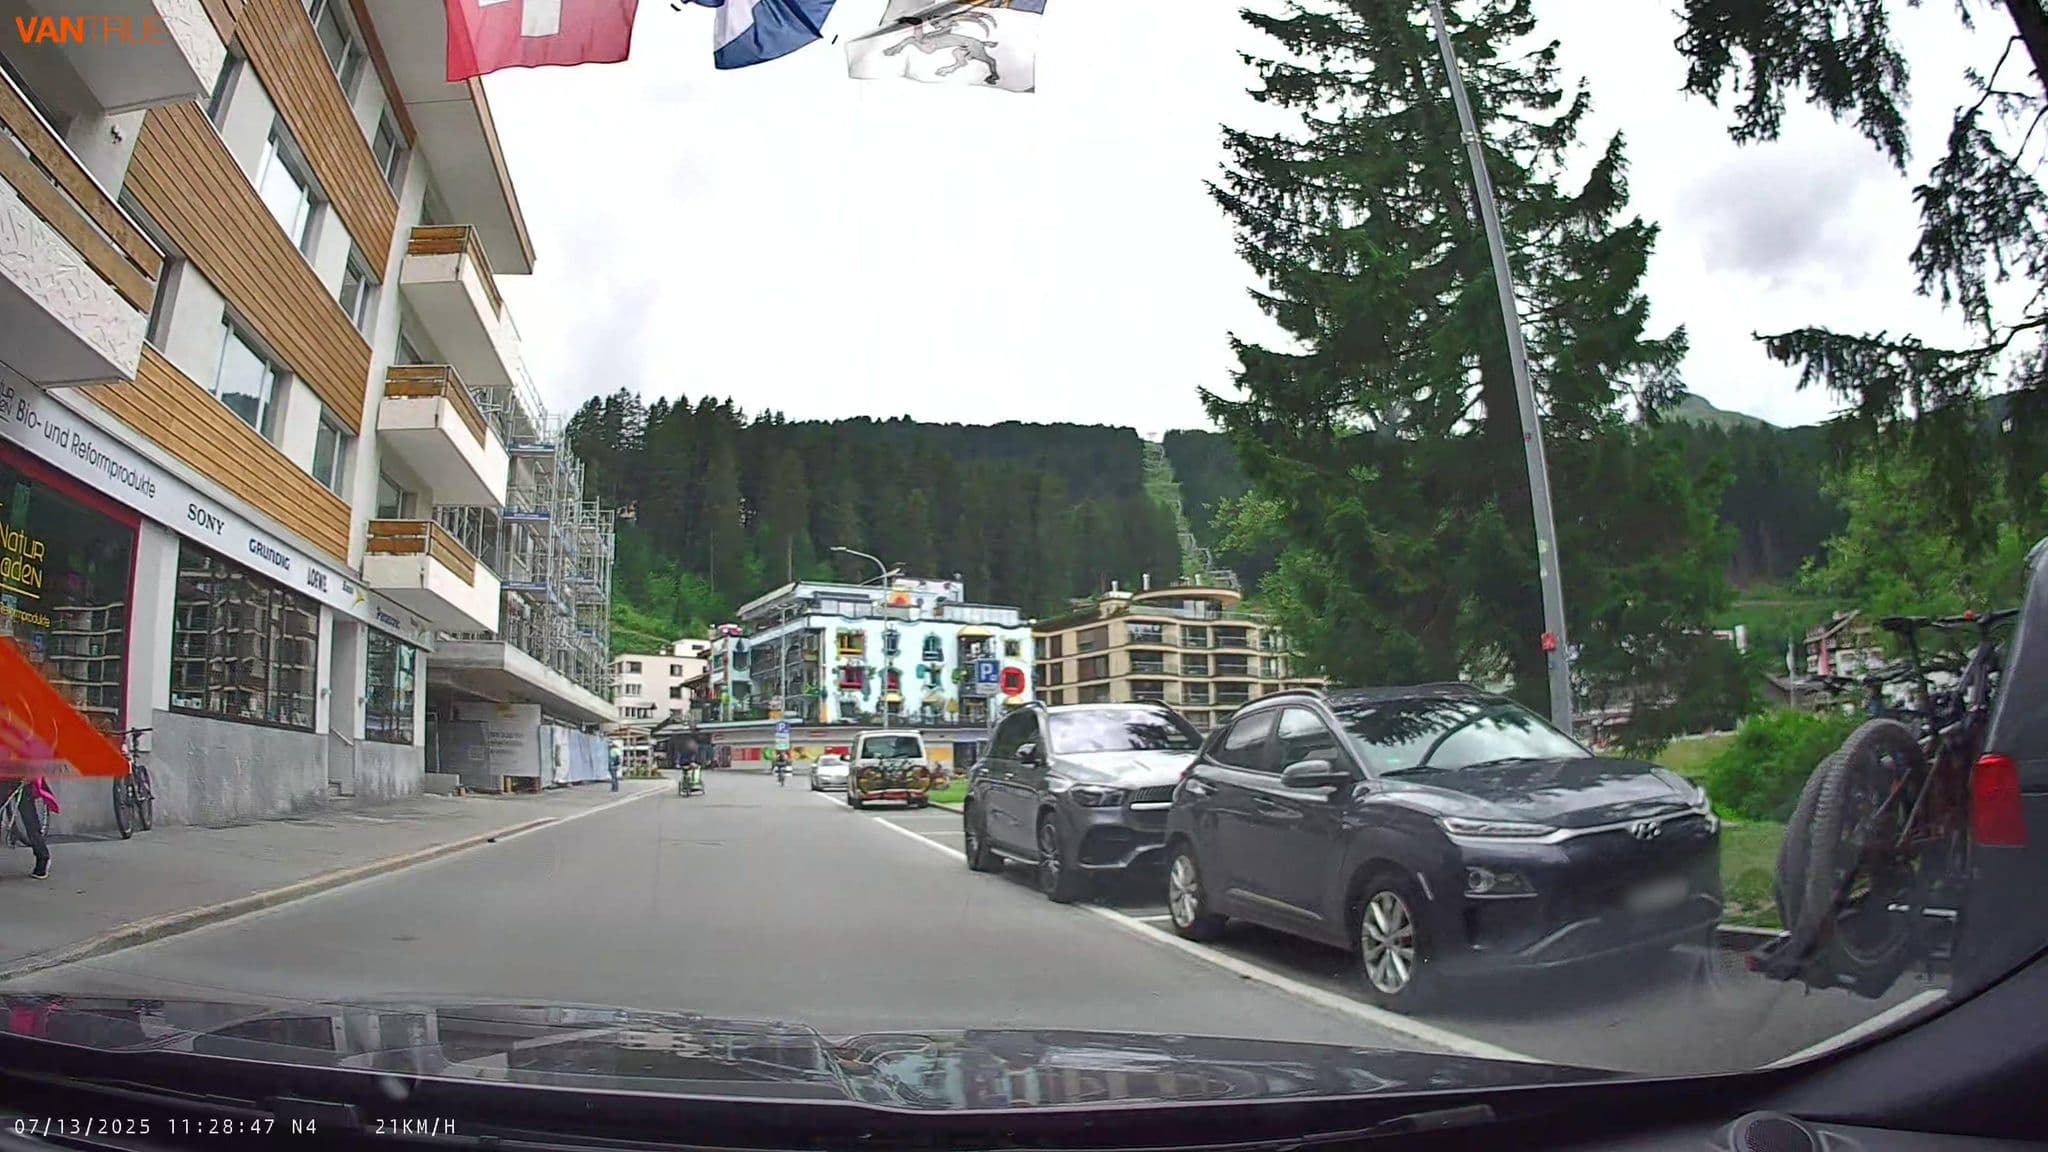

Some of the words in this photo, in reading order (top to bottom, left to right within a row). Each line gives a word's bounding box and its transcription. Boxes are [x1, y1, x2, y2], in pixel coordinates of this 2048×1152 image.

[16, 399, 41, 429] Bio-
[44, 420, 70, 448] und
[71, 432, 156, 498] Reformprodukte
[187, 503, 225, 535] SONY
[249, 538, 290, 570] GRUNDIG
[980, 662, 994, 680] P
